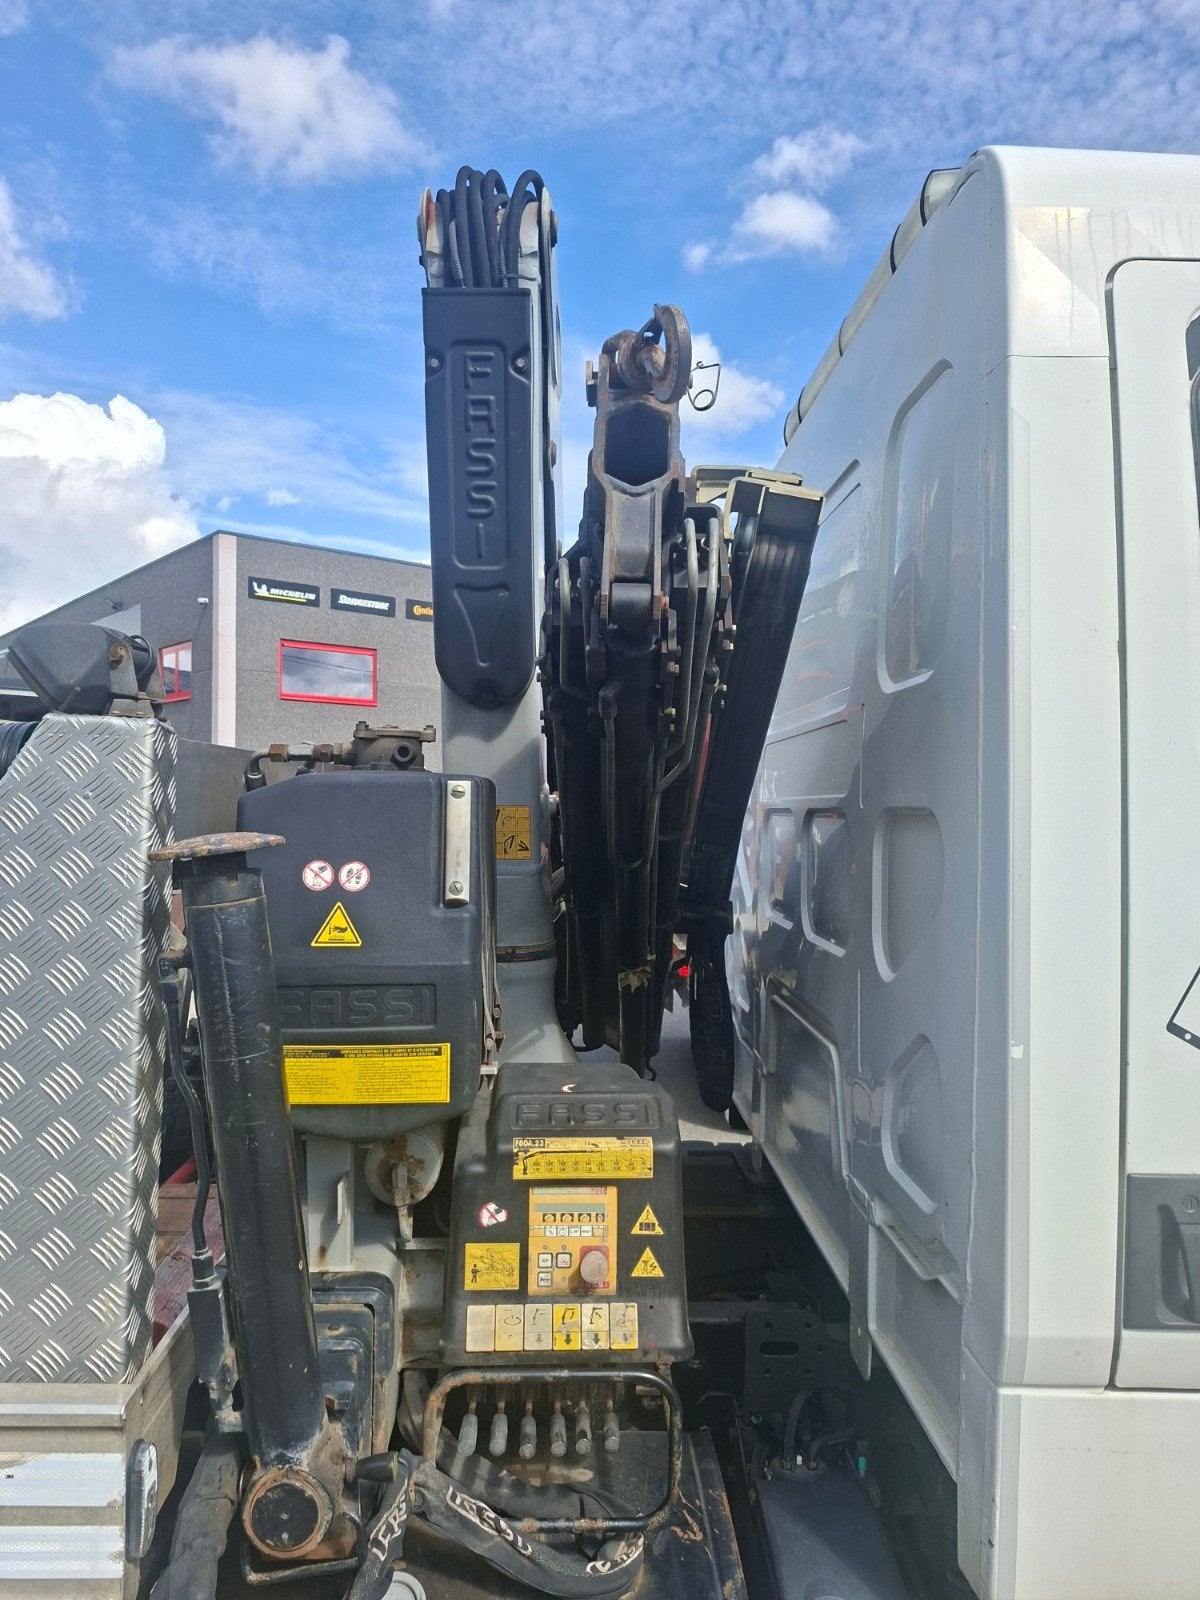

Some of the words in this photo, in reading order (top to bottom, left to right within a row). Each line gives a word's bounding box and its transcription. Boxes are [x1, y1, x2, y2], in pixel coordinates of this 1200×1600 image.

[464, 350, 499, 560] FASSI
[270, 588, 316, 600] MICHELIN
[338, 594, 390, 611] BRIDGESTONE
[279, 989, 431, 1026] FASSI
[516, 1102, 654, 1126] FASSI
